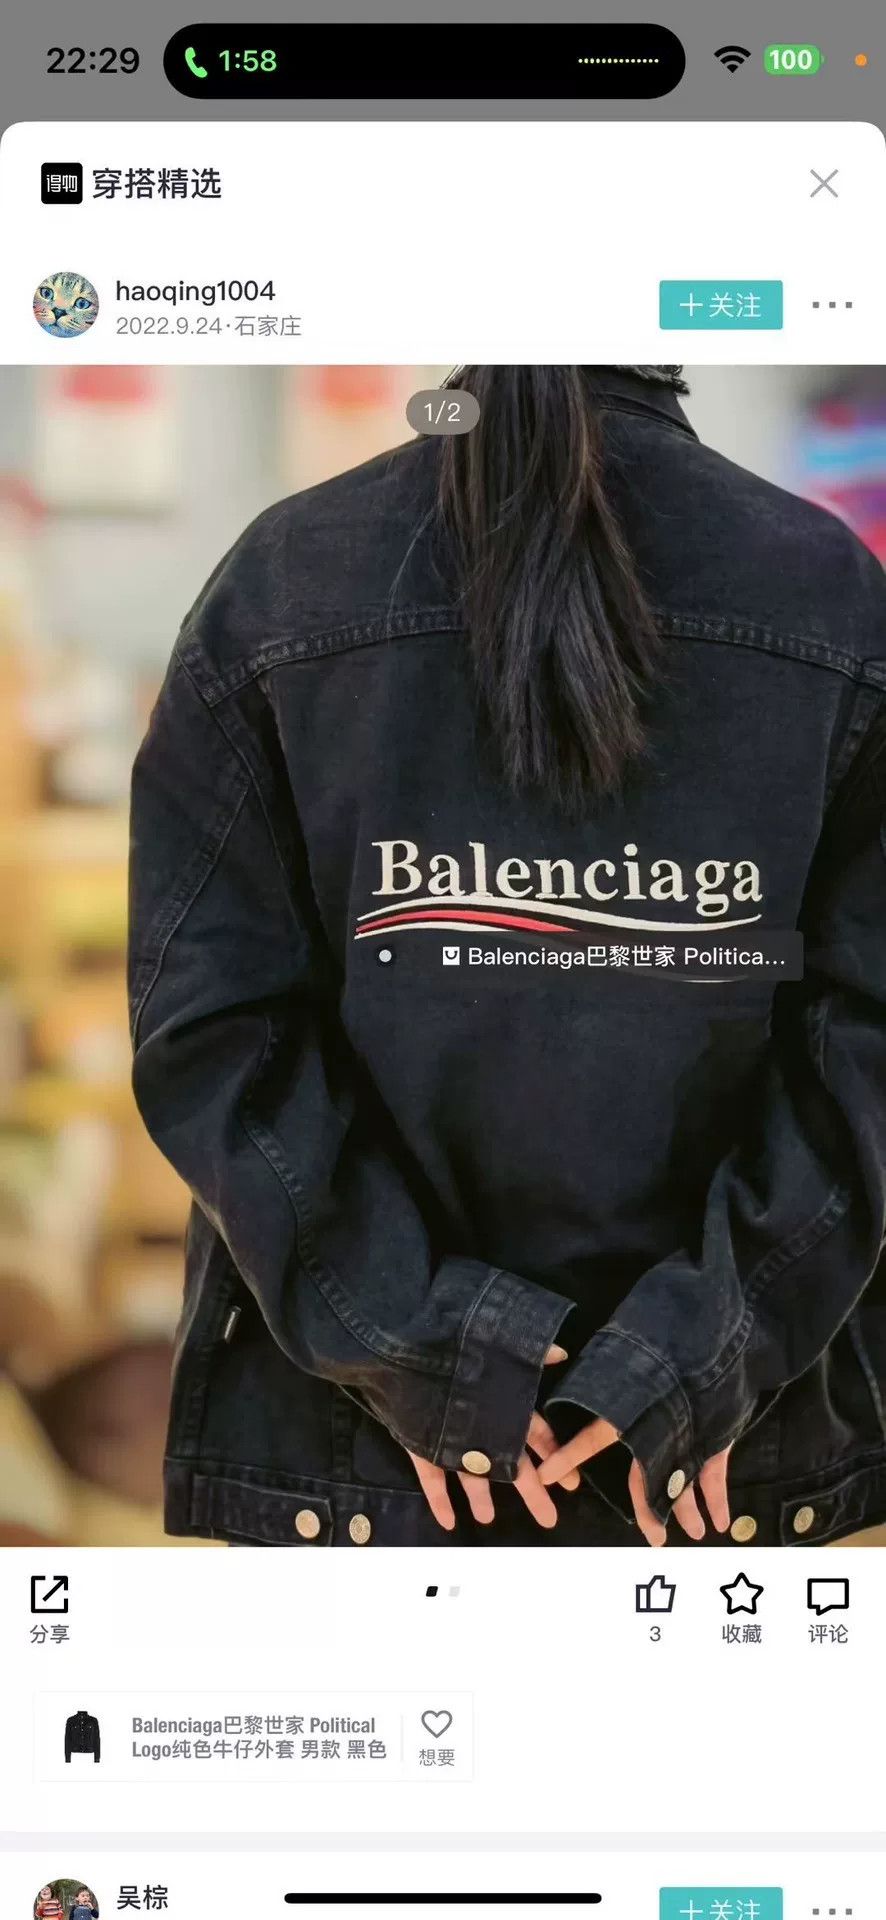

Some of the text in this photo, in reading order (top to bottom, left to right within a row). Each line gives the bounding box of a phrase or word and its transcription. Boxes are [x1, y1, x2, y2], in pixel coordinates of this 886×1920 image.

[46, 47, 140, 75] 22:29
[219, 49, 277, 72] 1:58
[769, 49, 812, 70] 100
[46, 174, 78, 193] 得物
[92, 167, 222, 199] 穿搭精选
[116, 280, 276, 304] haoqing1004
[371, 839, 763, 918] Balenciaga
[29, 1623, 70, 1645] 分享
[649, 1625, 662, 1642] 3
[721, 1623, 762, 1644] 收藏
[807, 1623, 849, 1644] 评论
[132, 1714, 376, 1736] Balenciaga巴黎世家 Political
[132, 1738, 387, 1761] Logo纯色牛仔外套 男款 黑色
[418, 1748, 456, 1767] 想要
[116, 1884, 169, 1911] 吴棕
